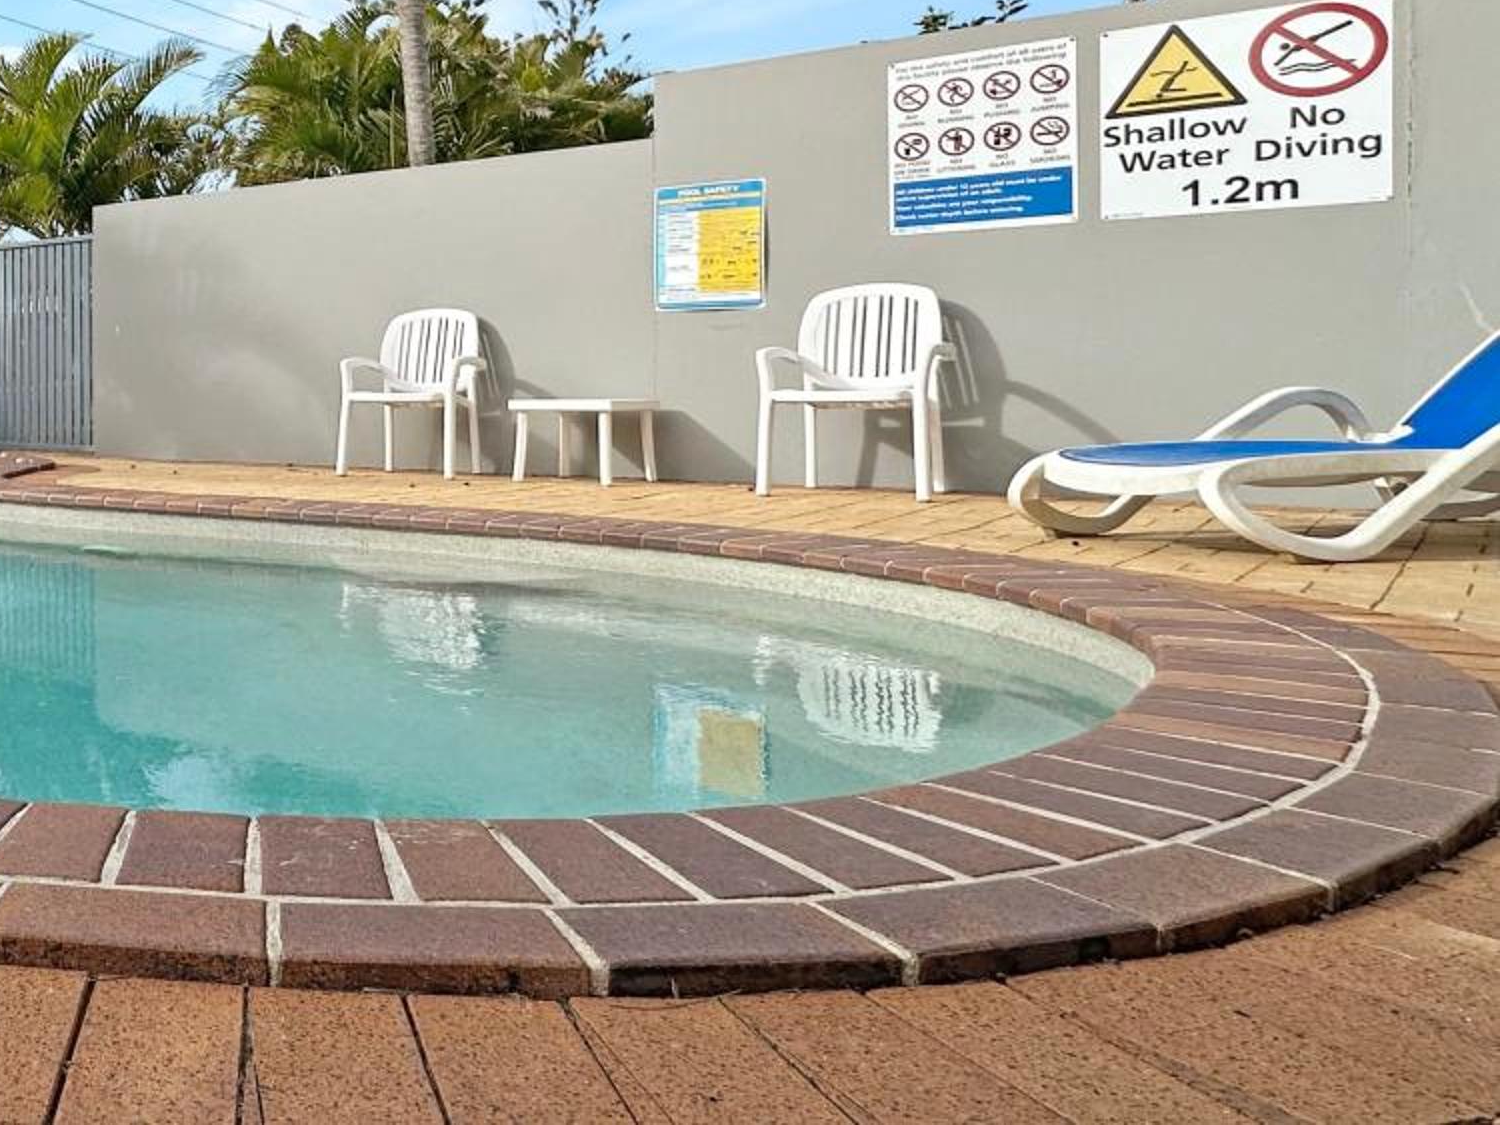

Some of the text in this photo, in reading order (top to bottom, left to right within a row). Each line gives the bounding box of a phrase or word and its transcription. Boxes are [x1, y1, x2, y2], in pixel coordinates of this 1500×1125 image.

[1290, 105, 1346, 129] No
[1103, 117, 1248, 148] Shallow
[1119, 148, 1230, 174] Water
[1254, 133, 1383, 163] Diving
[1181, 176, 1300, 207] 1.2m
